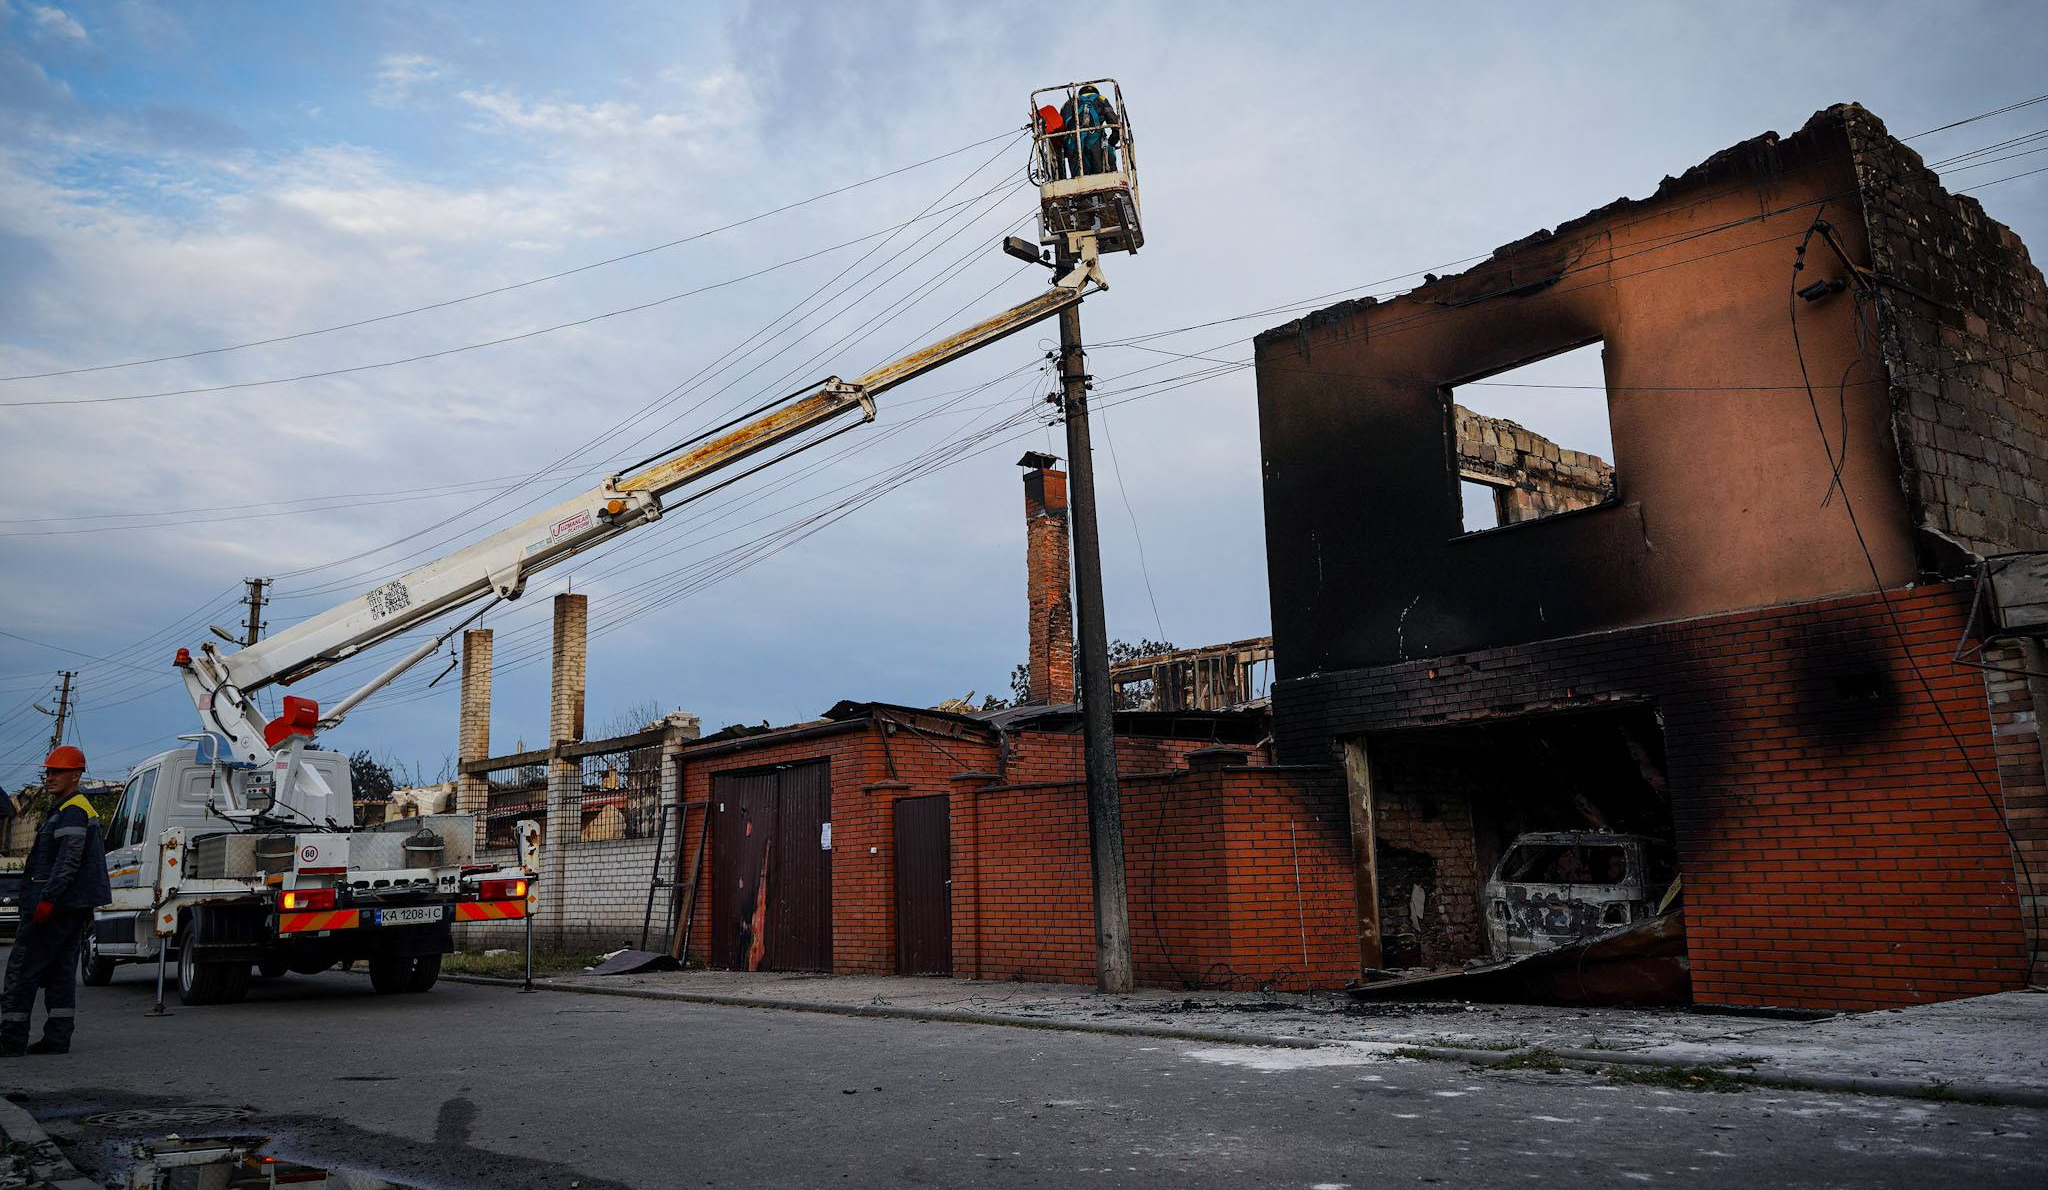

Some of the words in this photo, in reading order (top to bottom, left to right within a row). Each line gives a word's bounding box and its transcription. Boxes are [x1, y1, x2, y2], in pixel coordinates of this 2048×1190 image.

[305, 849, 315, 858] 60
[382, 910, 398, 921] KA
[400, 909, 424, 920] 1208
